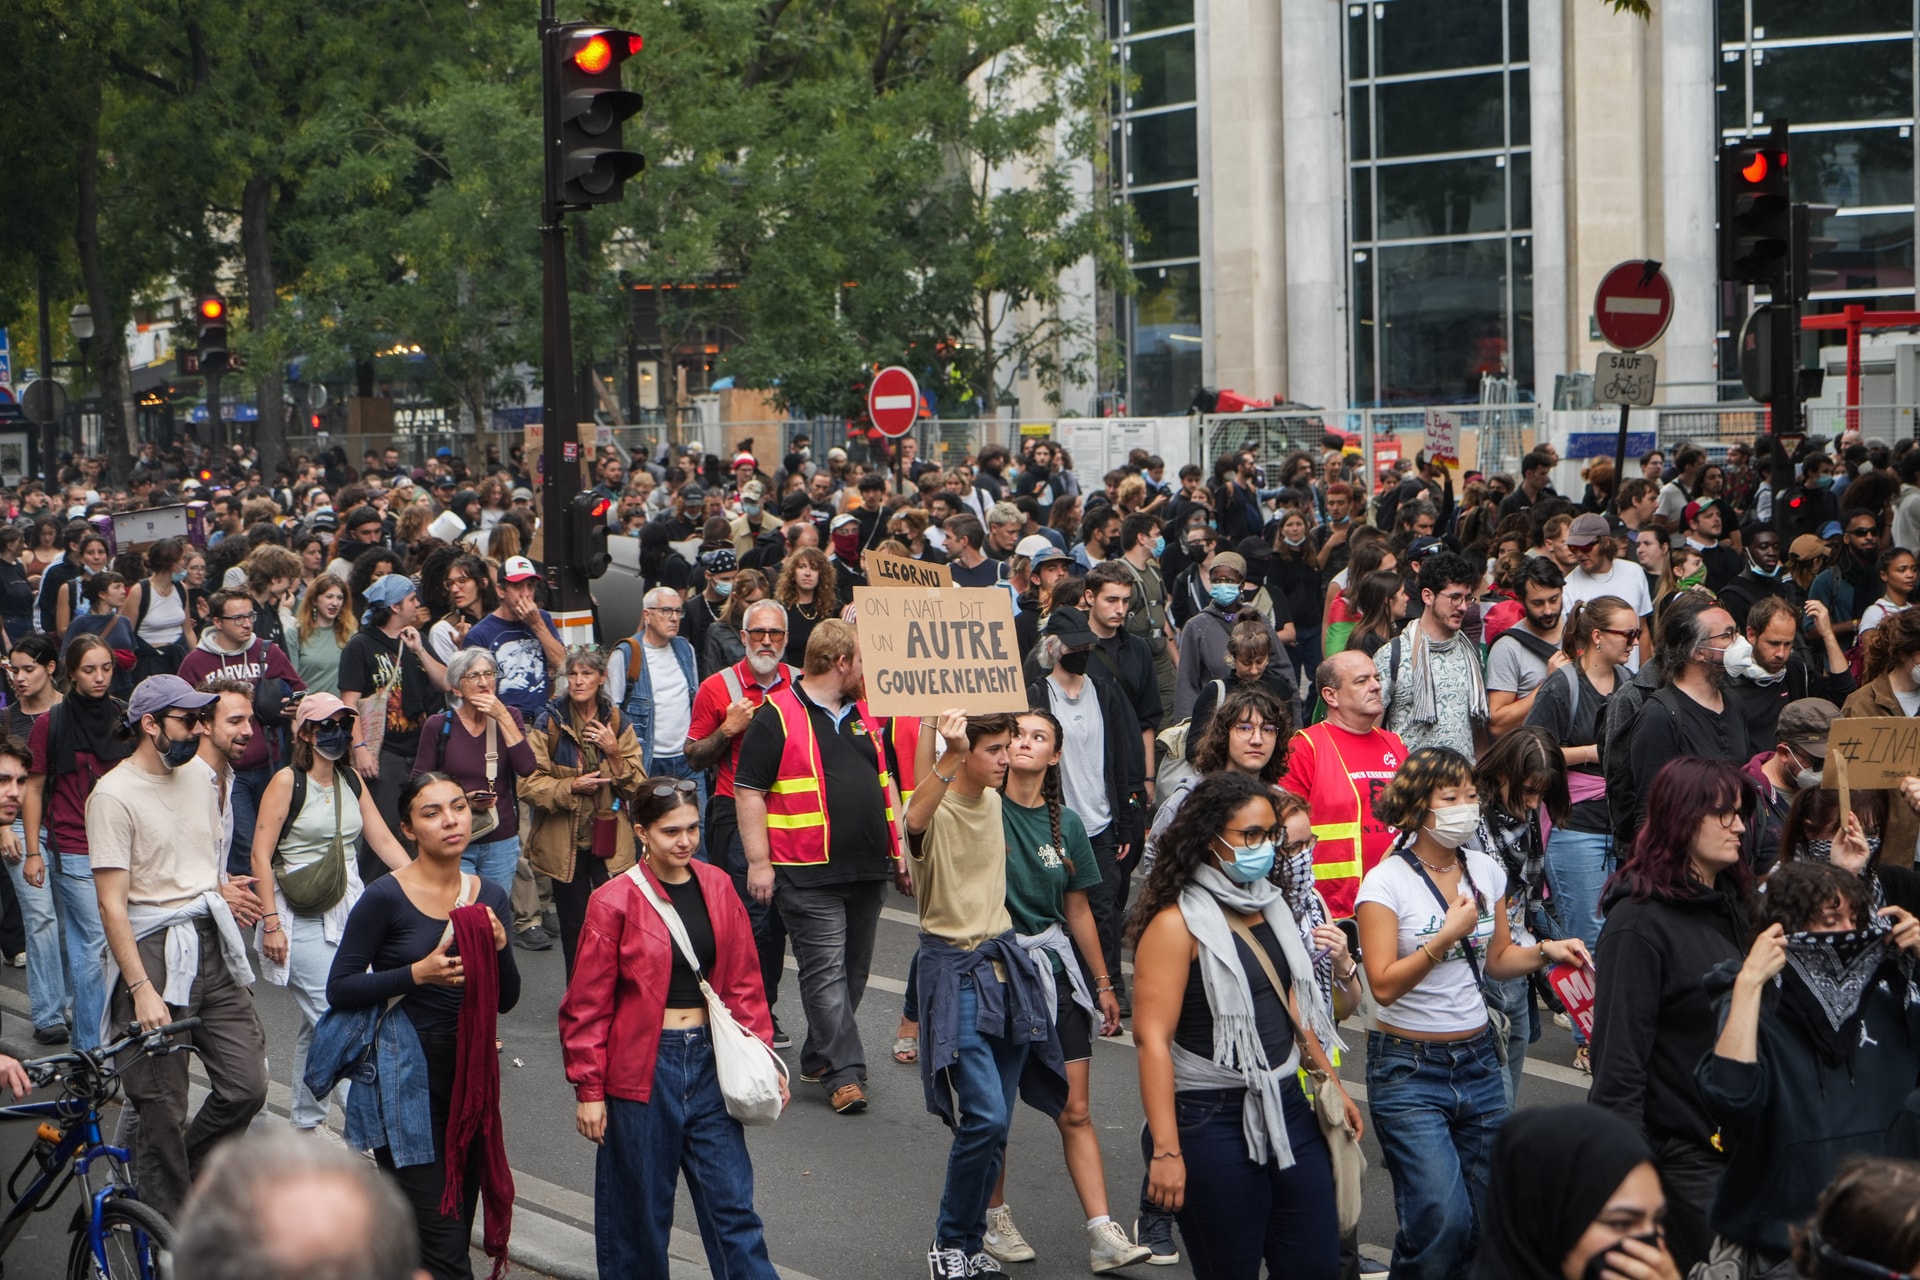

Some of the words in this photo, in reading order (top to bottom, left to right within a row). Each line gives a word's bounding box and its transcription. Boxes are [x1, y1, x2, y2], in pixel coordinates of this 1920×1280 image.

[1611, 356, 1642, 369] SAUF
[876, 559, 940, 587] LECORNU
[865, 597, 890, 617] ON
[871, 634, 893, 652] UN
[907, 621, 1008, 660] AUTRE
[876, 666, 1018, 695] GOUVERNEMENT
